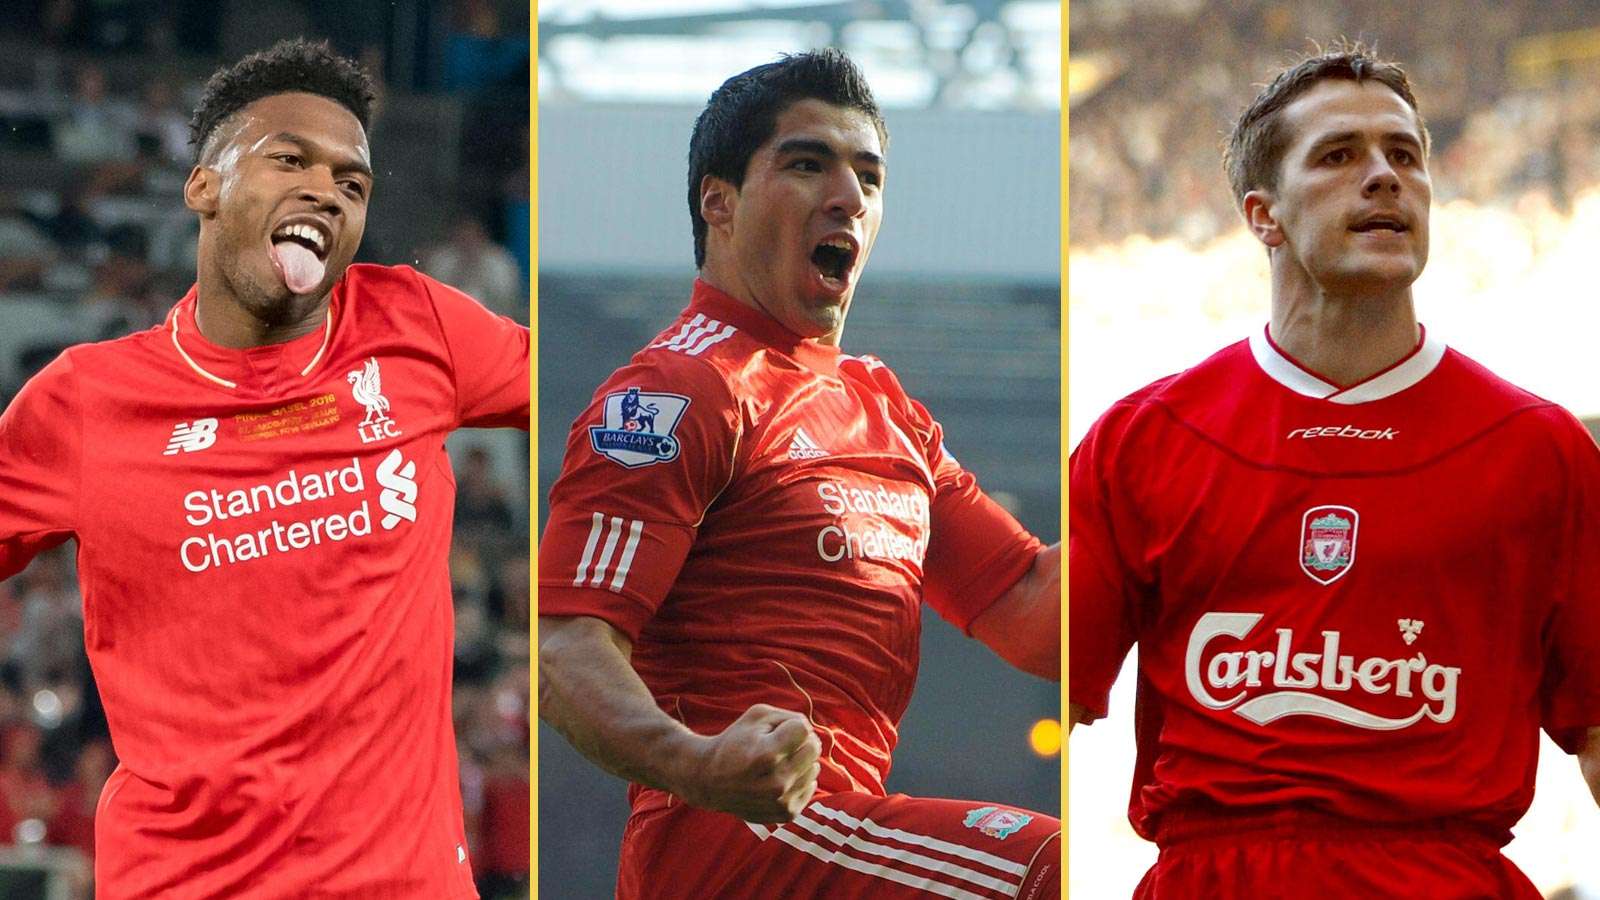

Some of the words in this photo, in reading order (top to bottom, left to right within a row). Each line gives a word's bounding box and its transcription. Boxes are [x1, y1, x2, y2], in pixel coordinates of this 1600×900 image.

[309, 393, 336, 408] 2016
[602, 432, 656, 446] BARCLAYS
[1287, 424, 1400, 441] reebok
[183, 457, 365, 527] Standard
[816, 482, 925, 521] Standard
[179, 501, 372, 573] Chartered
[816, 525, 926, 562] Chartered
[1184, 611, 1462, 729] Carlsberg
